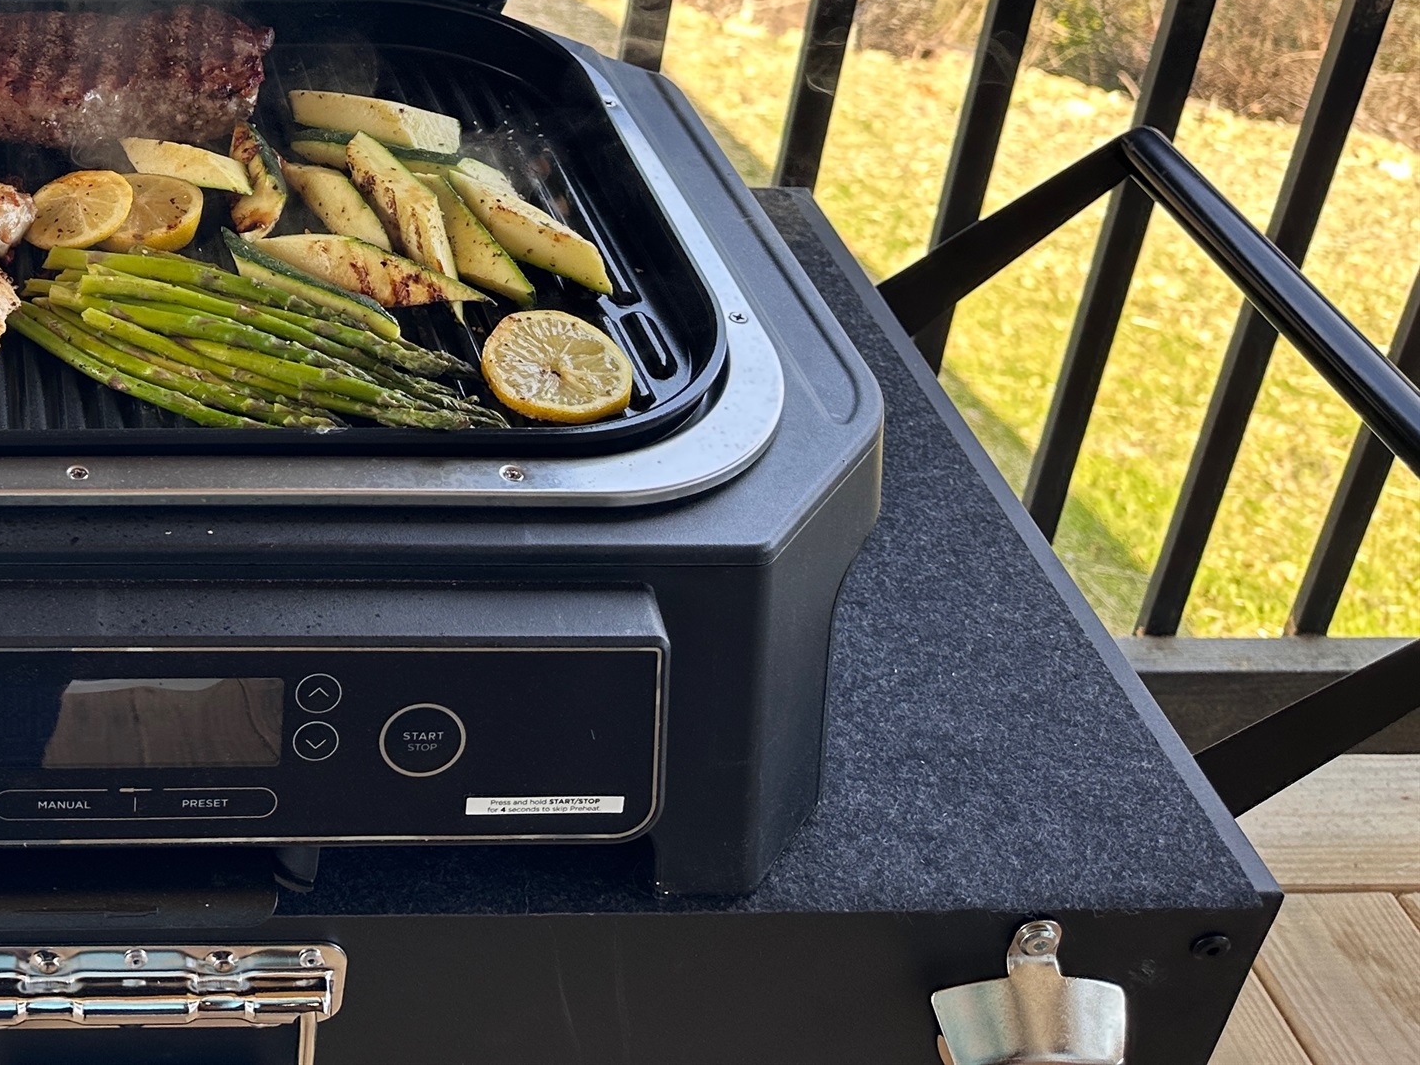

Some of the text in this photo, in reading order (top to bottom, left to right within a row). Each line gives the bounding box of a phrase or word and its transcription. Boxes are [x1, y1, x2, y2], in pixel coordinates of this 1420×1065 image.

[402, 731, 444, 741] START
[407, 743, 438, 751] STOP
[37, 800, 91, 809] MANUAL
[182, 799, 229, 808] PRESET
